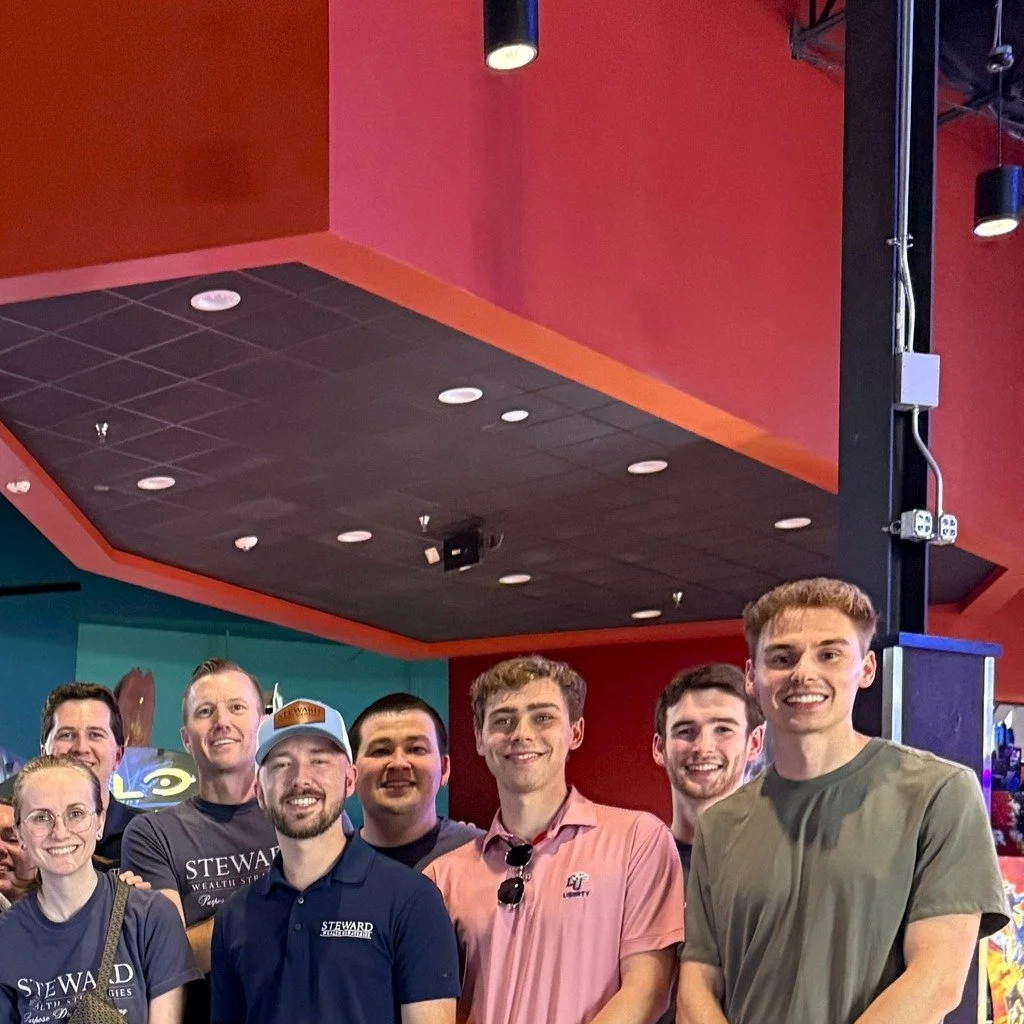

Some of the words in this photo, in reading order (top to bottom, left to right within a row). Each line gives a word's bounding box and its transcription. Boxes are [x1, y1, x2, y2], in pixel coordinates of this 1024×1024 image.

[191, 878, 236, 892] WEALTH
[321, 920, 374, 932] STEWARD
[17, 963, 134, 998] STEWAD
